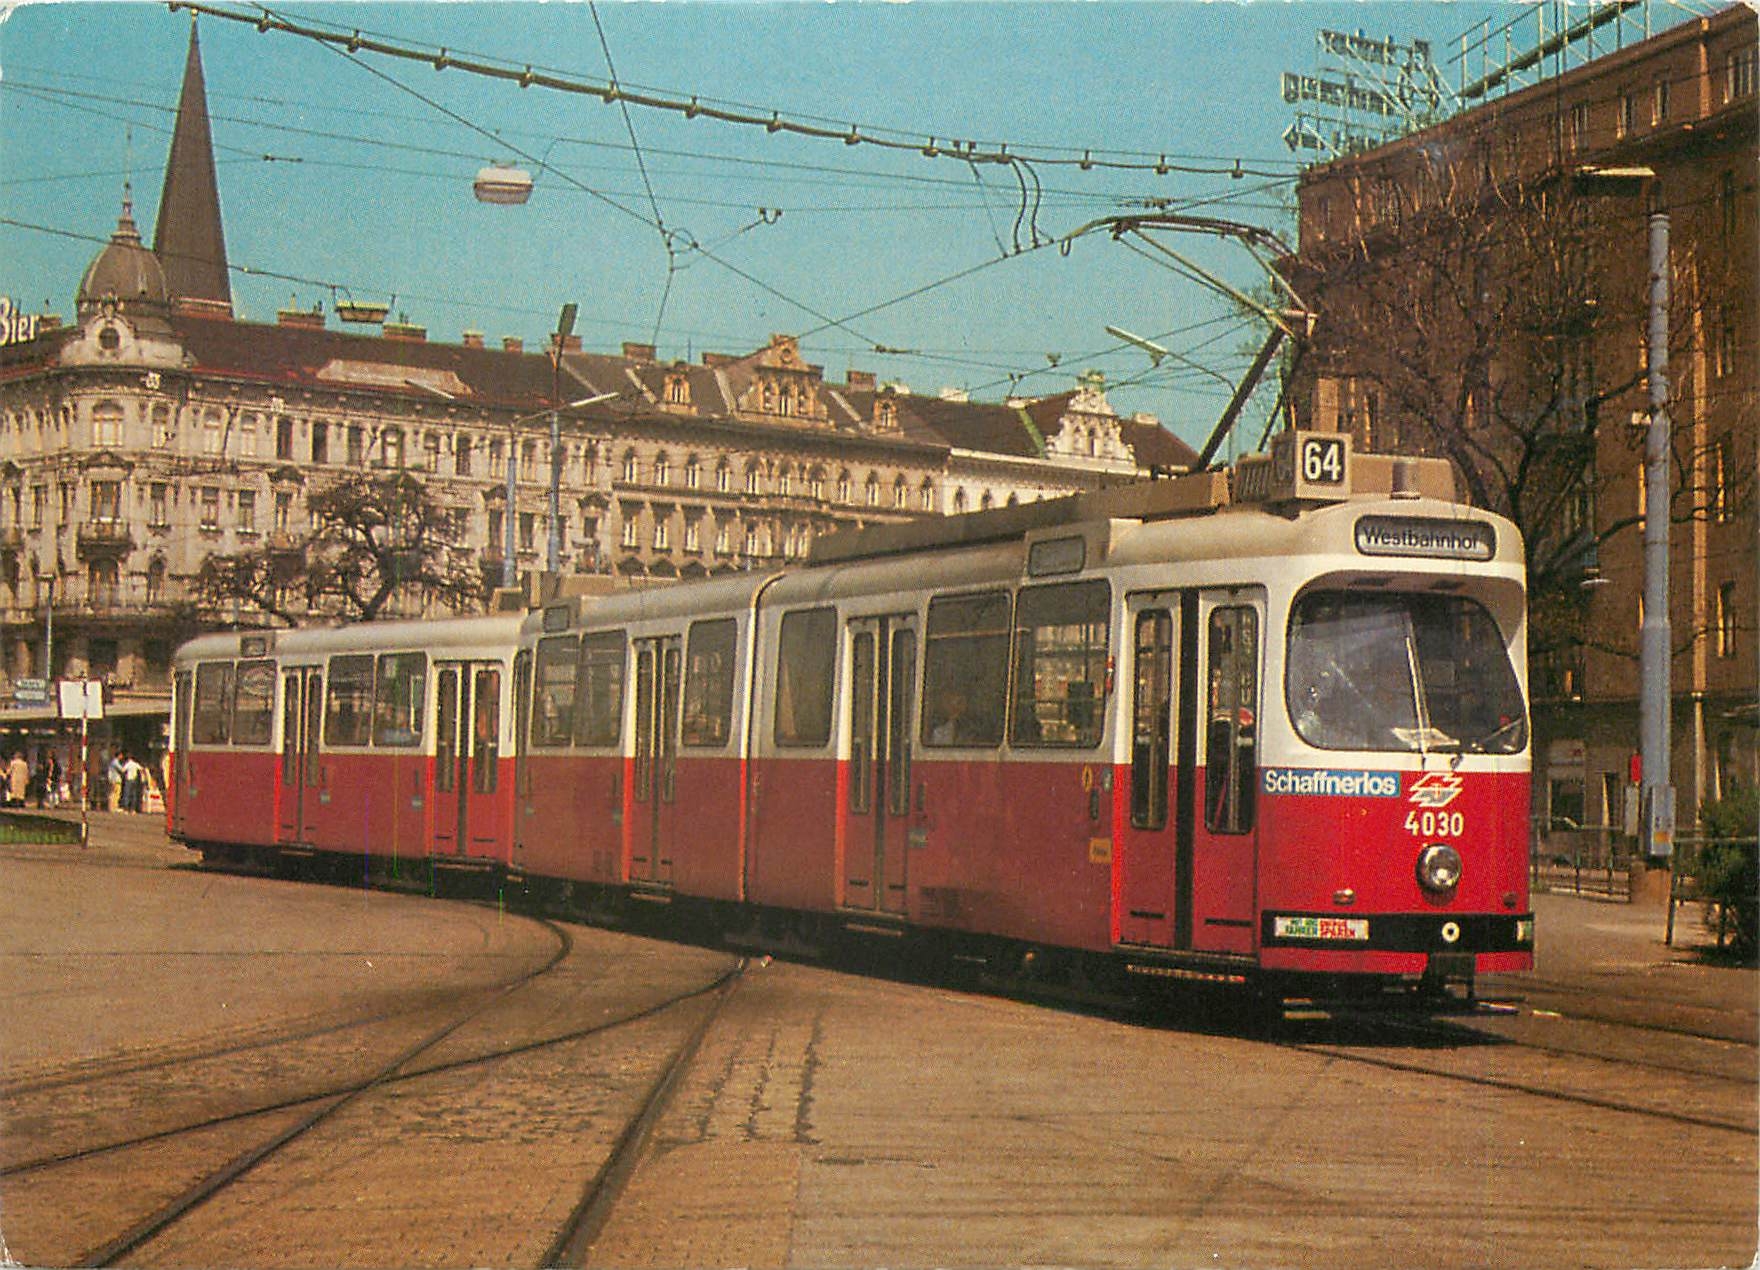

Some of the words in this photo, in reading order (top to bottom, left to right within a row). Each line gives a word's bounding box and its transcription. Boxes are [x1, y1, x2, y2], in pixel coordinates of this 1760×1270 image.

[1304, 441, 1341, 481] 64
[1363, 524, 1479, 550] Westbahnhof
[1265, 769, 1396, 795] Schaffnerlos
[1404, 811, 1464, 837] 4030
